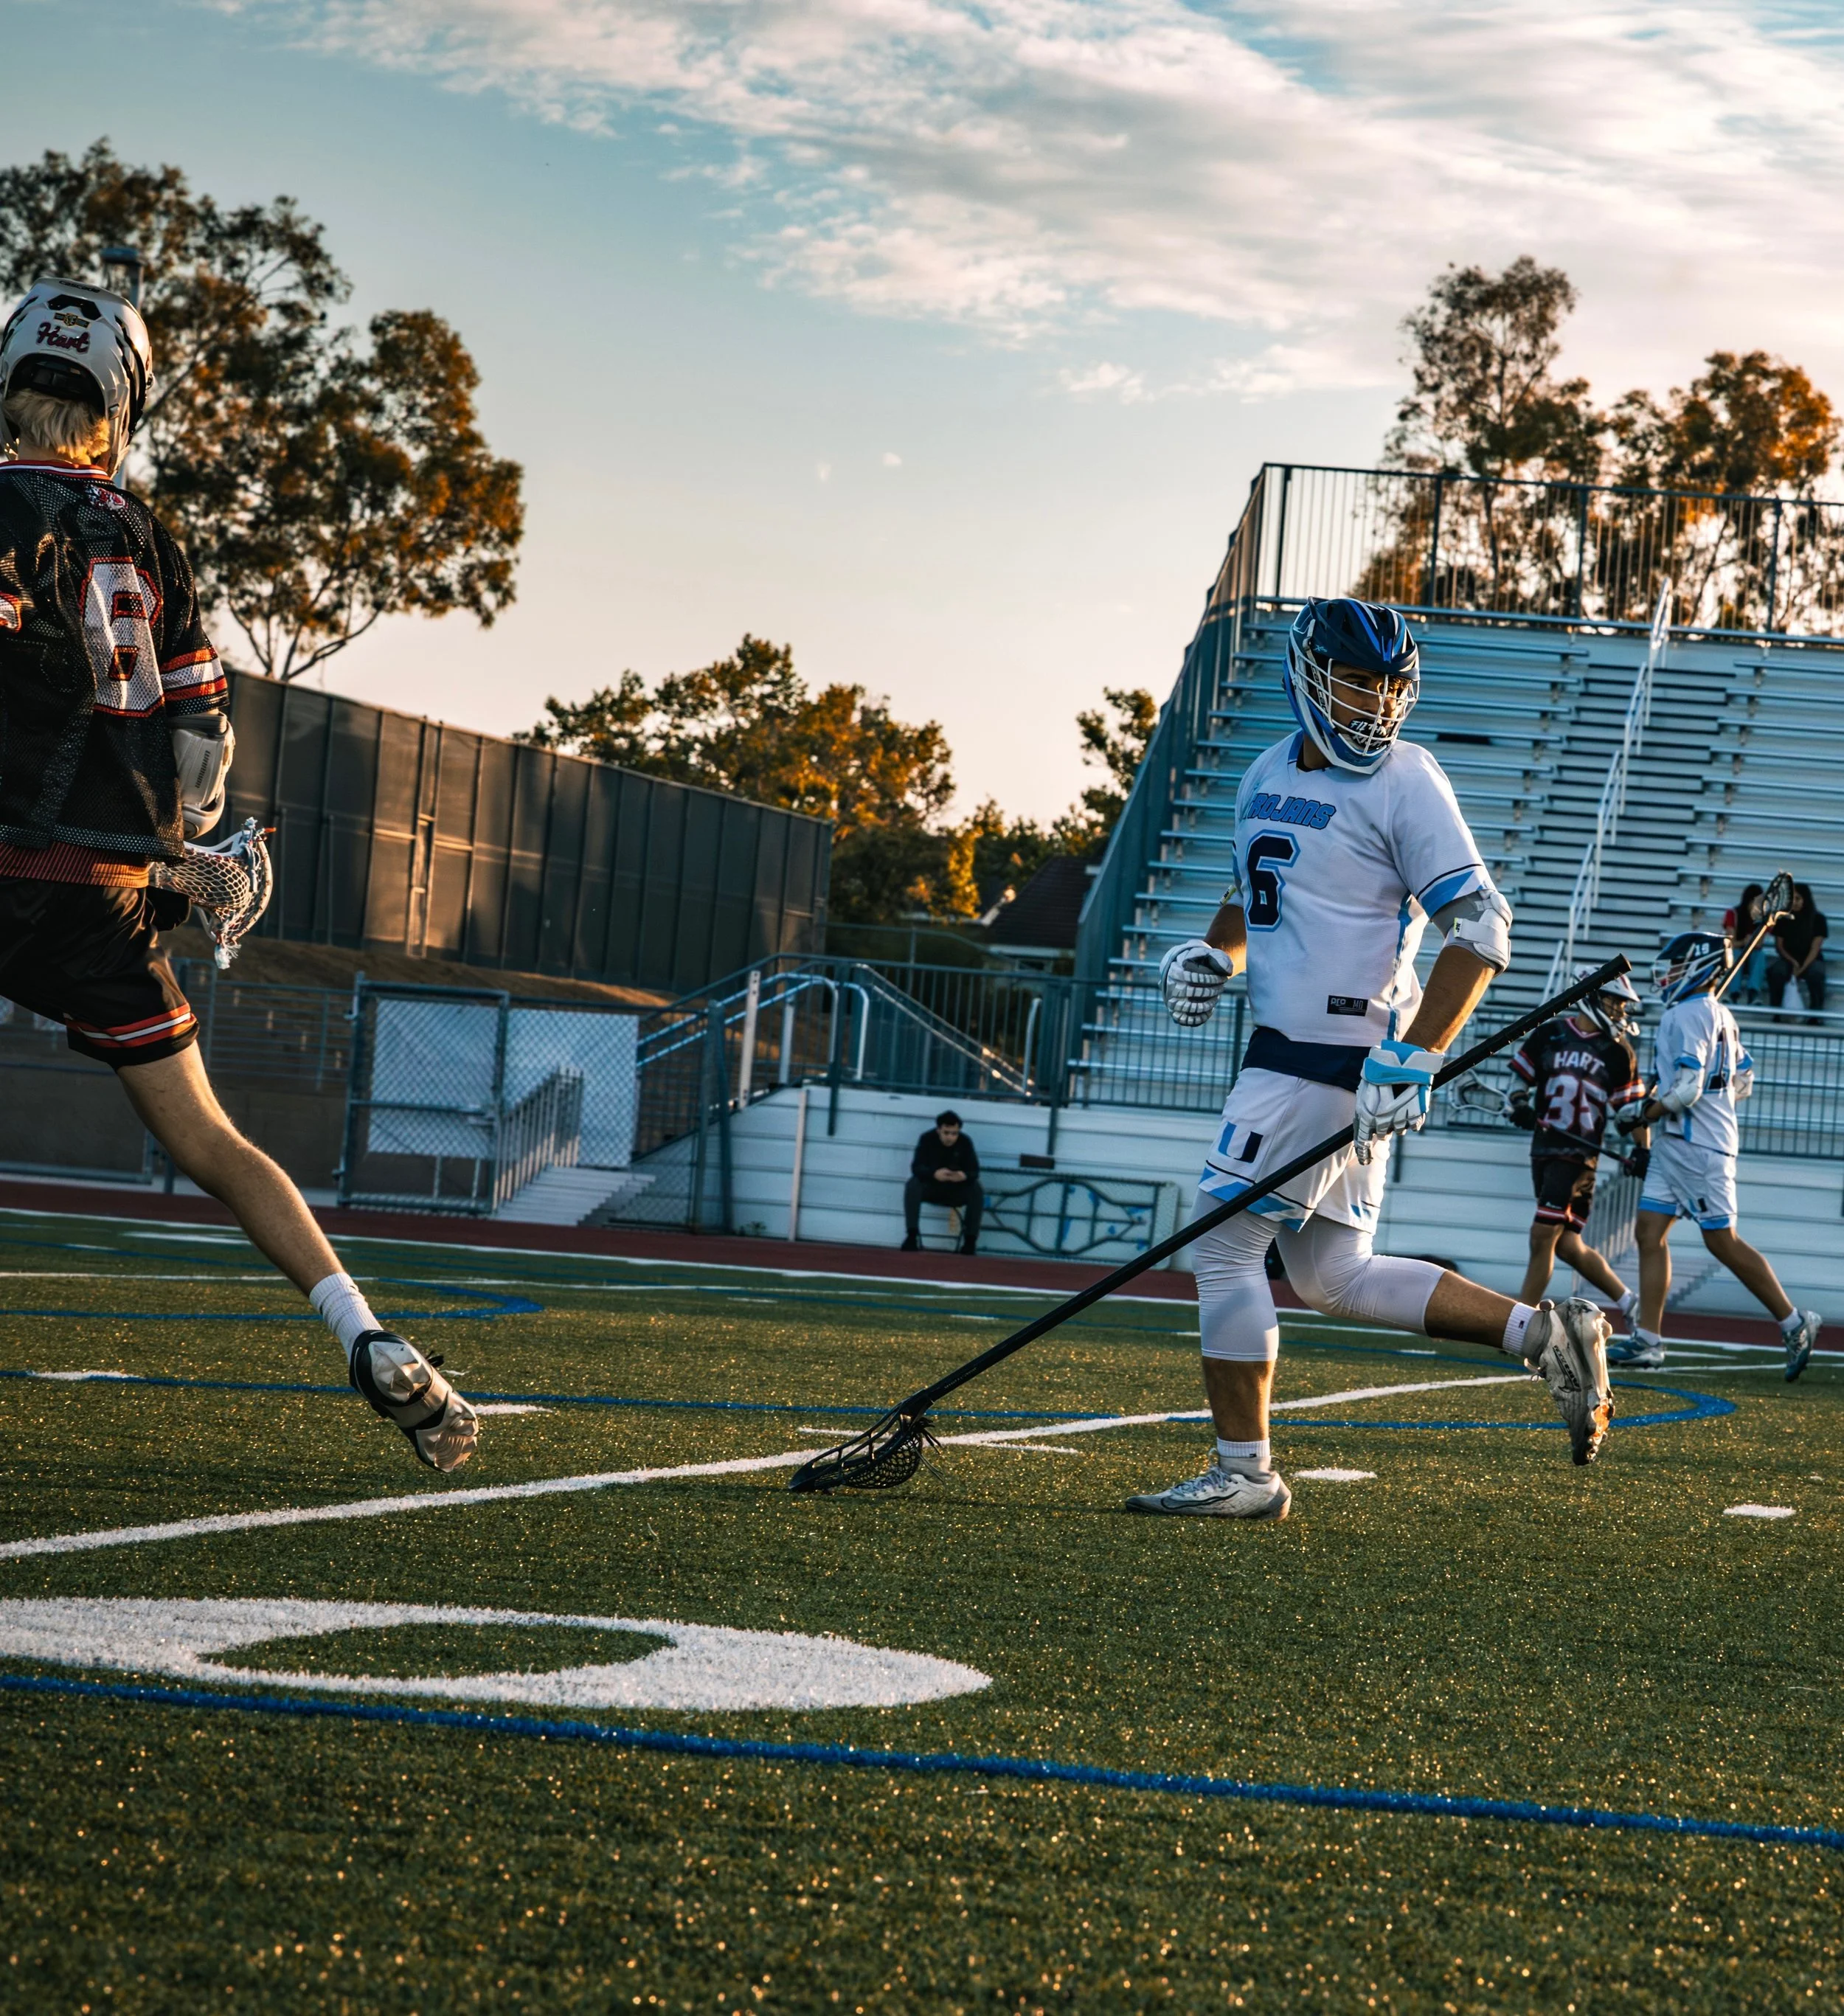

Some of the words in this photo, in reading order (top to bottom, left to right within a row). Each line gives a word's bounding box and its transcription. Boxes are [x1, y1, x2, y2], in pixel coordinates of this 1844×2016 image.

[36, 322, 90, 353] Hart
[1244, 792, 1337, 831] ROJANS
[1247, 829, 1301, 932] 6
[1553, 1050, 1606, 1075] HART
[1544, 1073, 1609, 1132] 35
